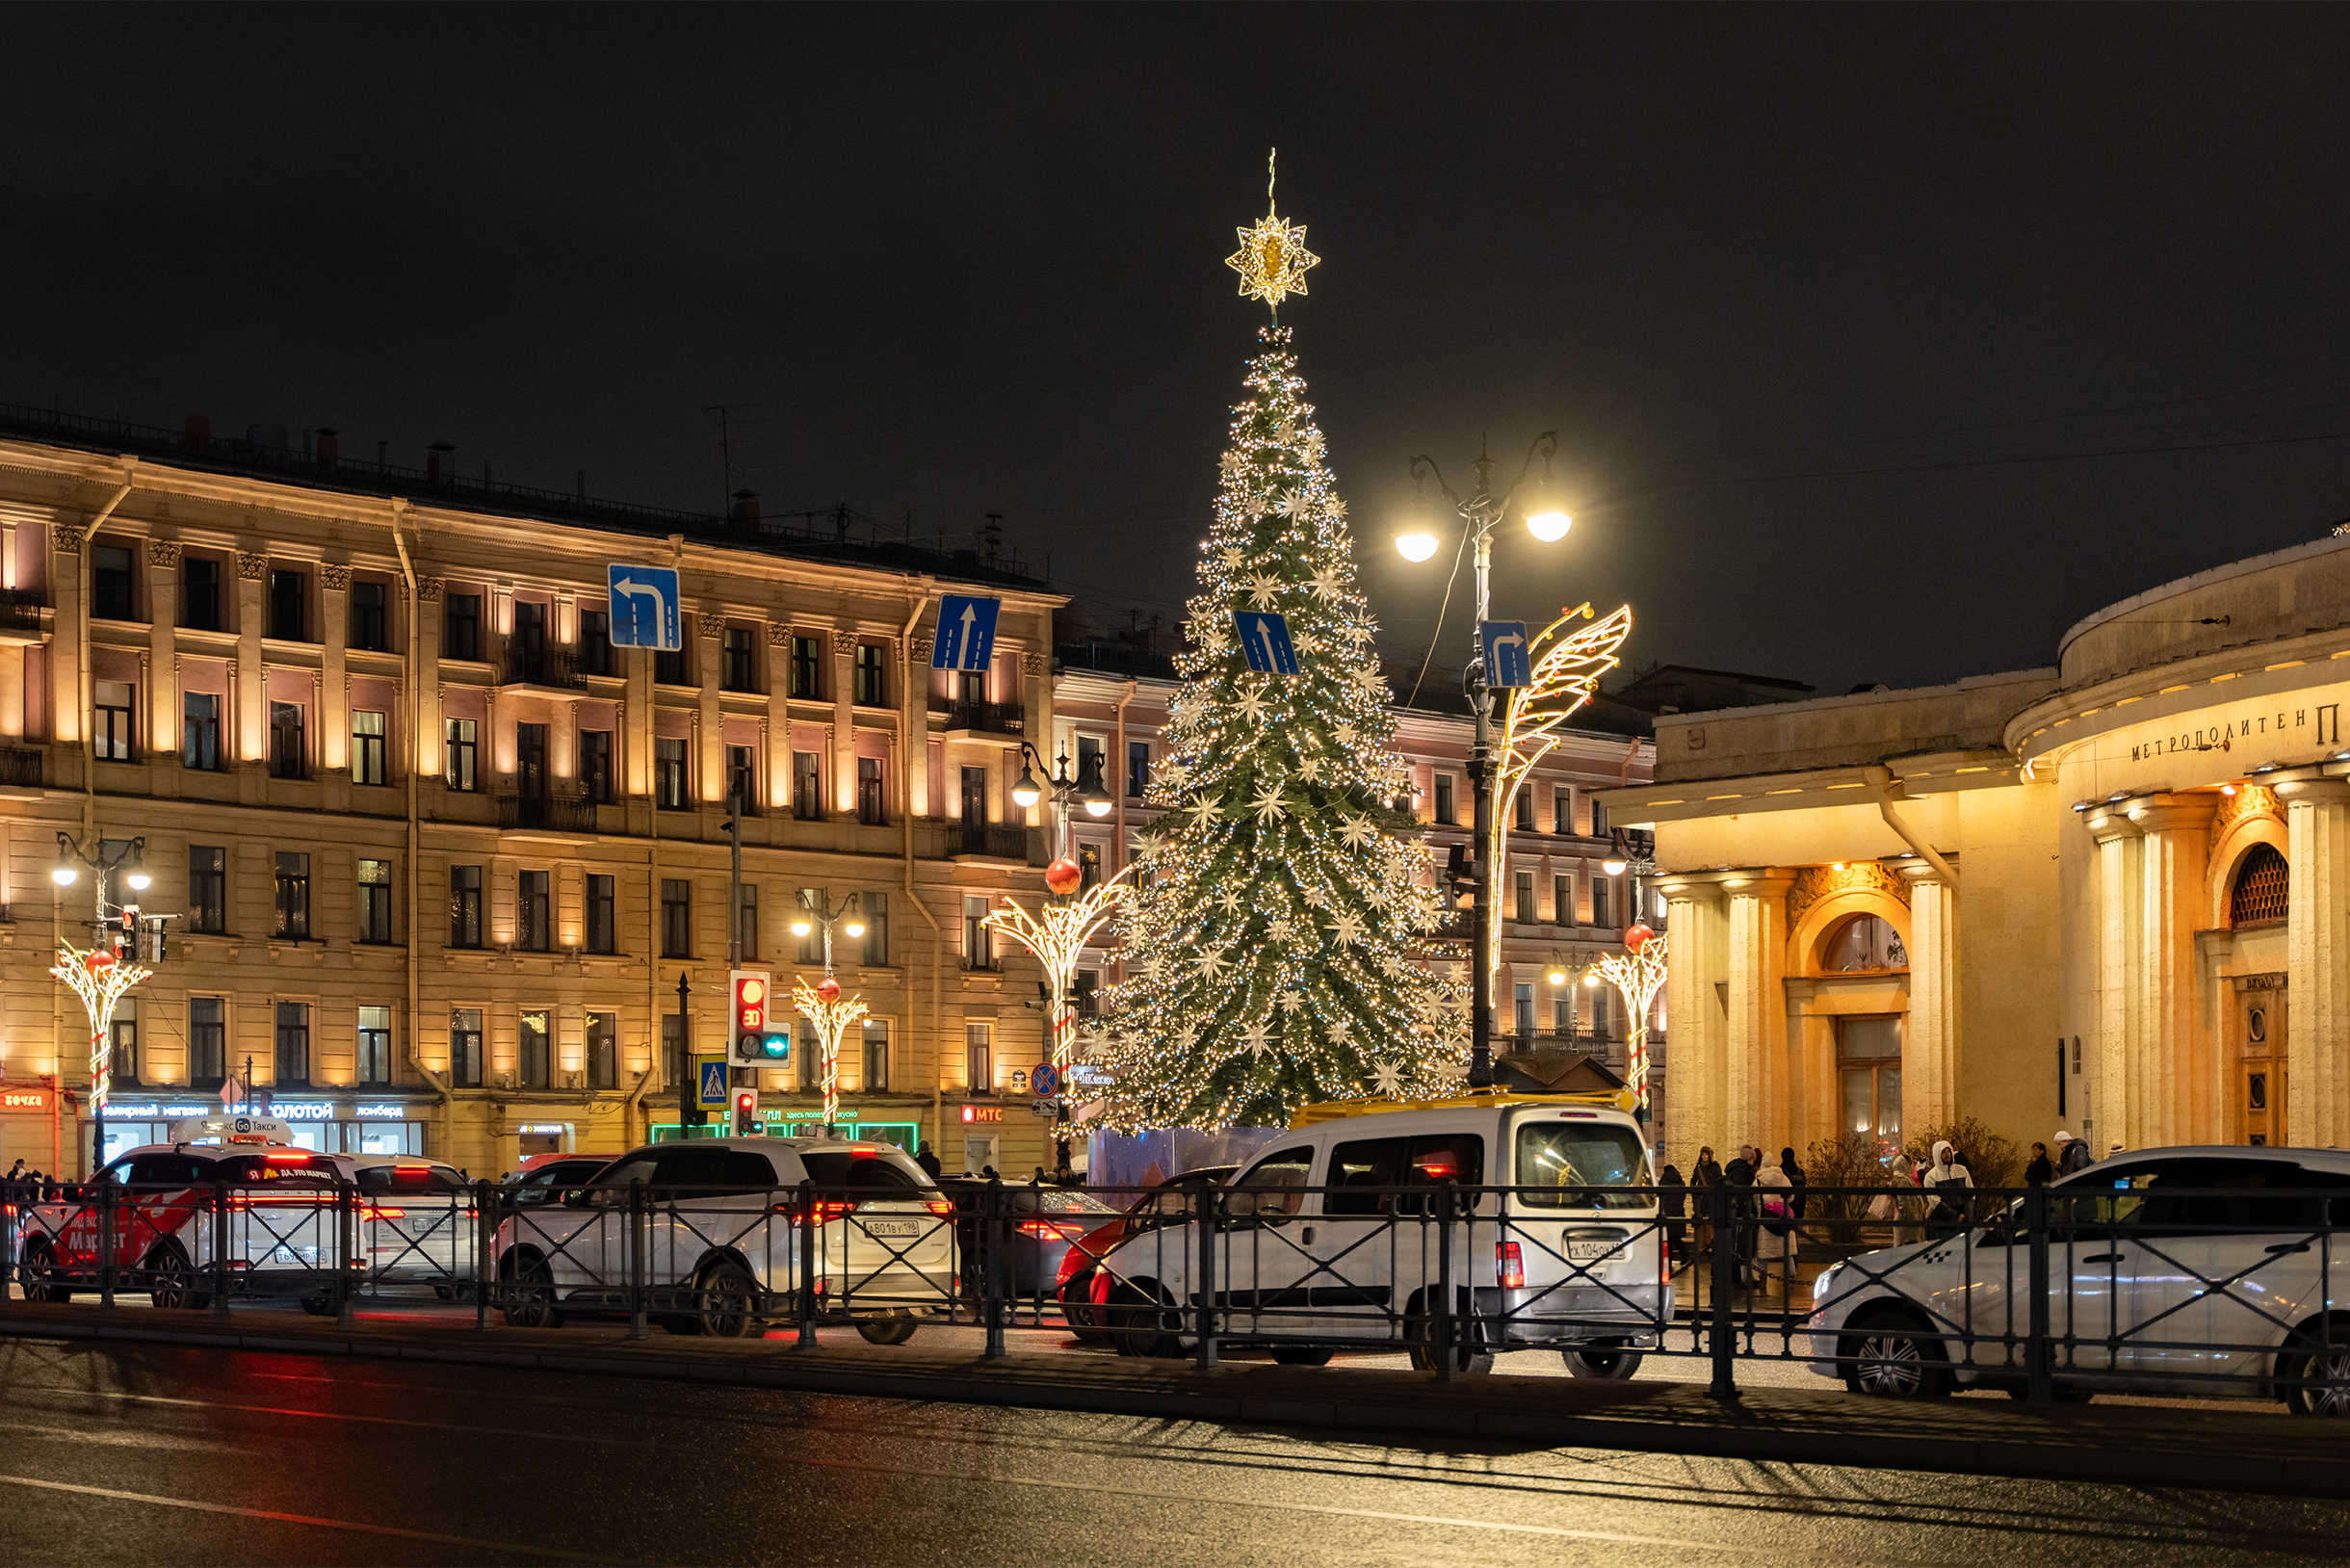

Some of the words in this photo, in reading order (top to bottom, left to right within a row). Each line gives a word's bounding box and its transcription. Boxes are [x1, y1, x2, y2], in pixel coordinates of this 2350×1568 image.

[2132, 709, 2306, 762] МЕТРОПОЛИТЕН
[744, 1010, 760, 1026] 30
[163, 1106, 209, 1117] магазин
[356, 1105, 404, 1118] ломбард
[976, 1108, 1003, 1121] МТС
[237, 1120, 249, 1131] Go
[251, 1120, 276, 1131] Такси
[293, 1168, 306, 1177] ЭТО
[305, 1169, 332, 1180] МАРКЕТ
